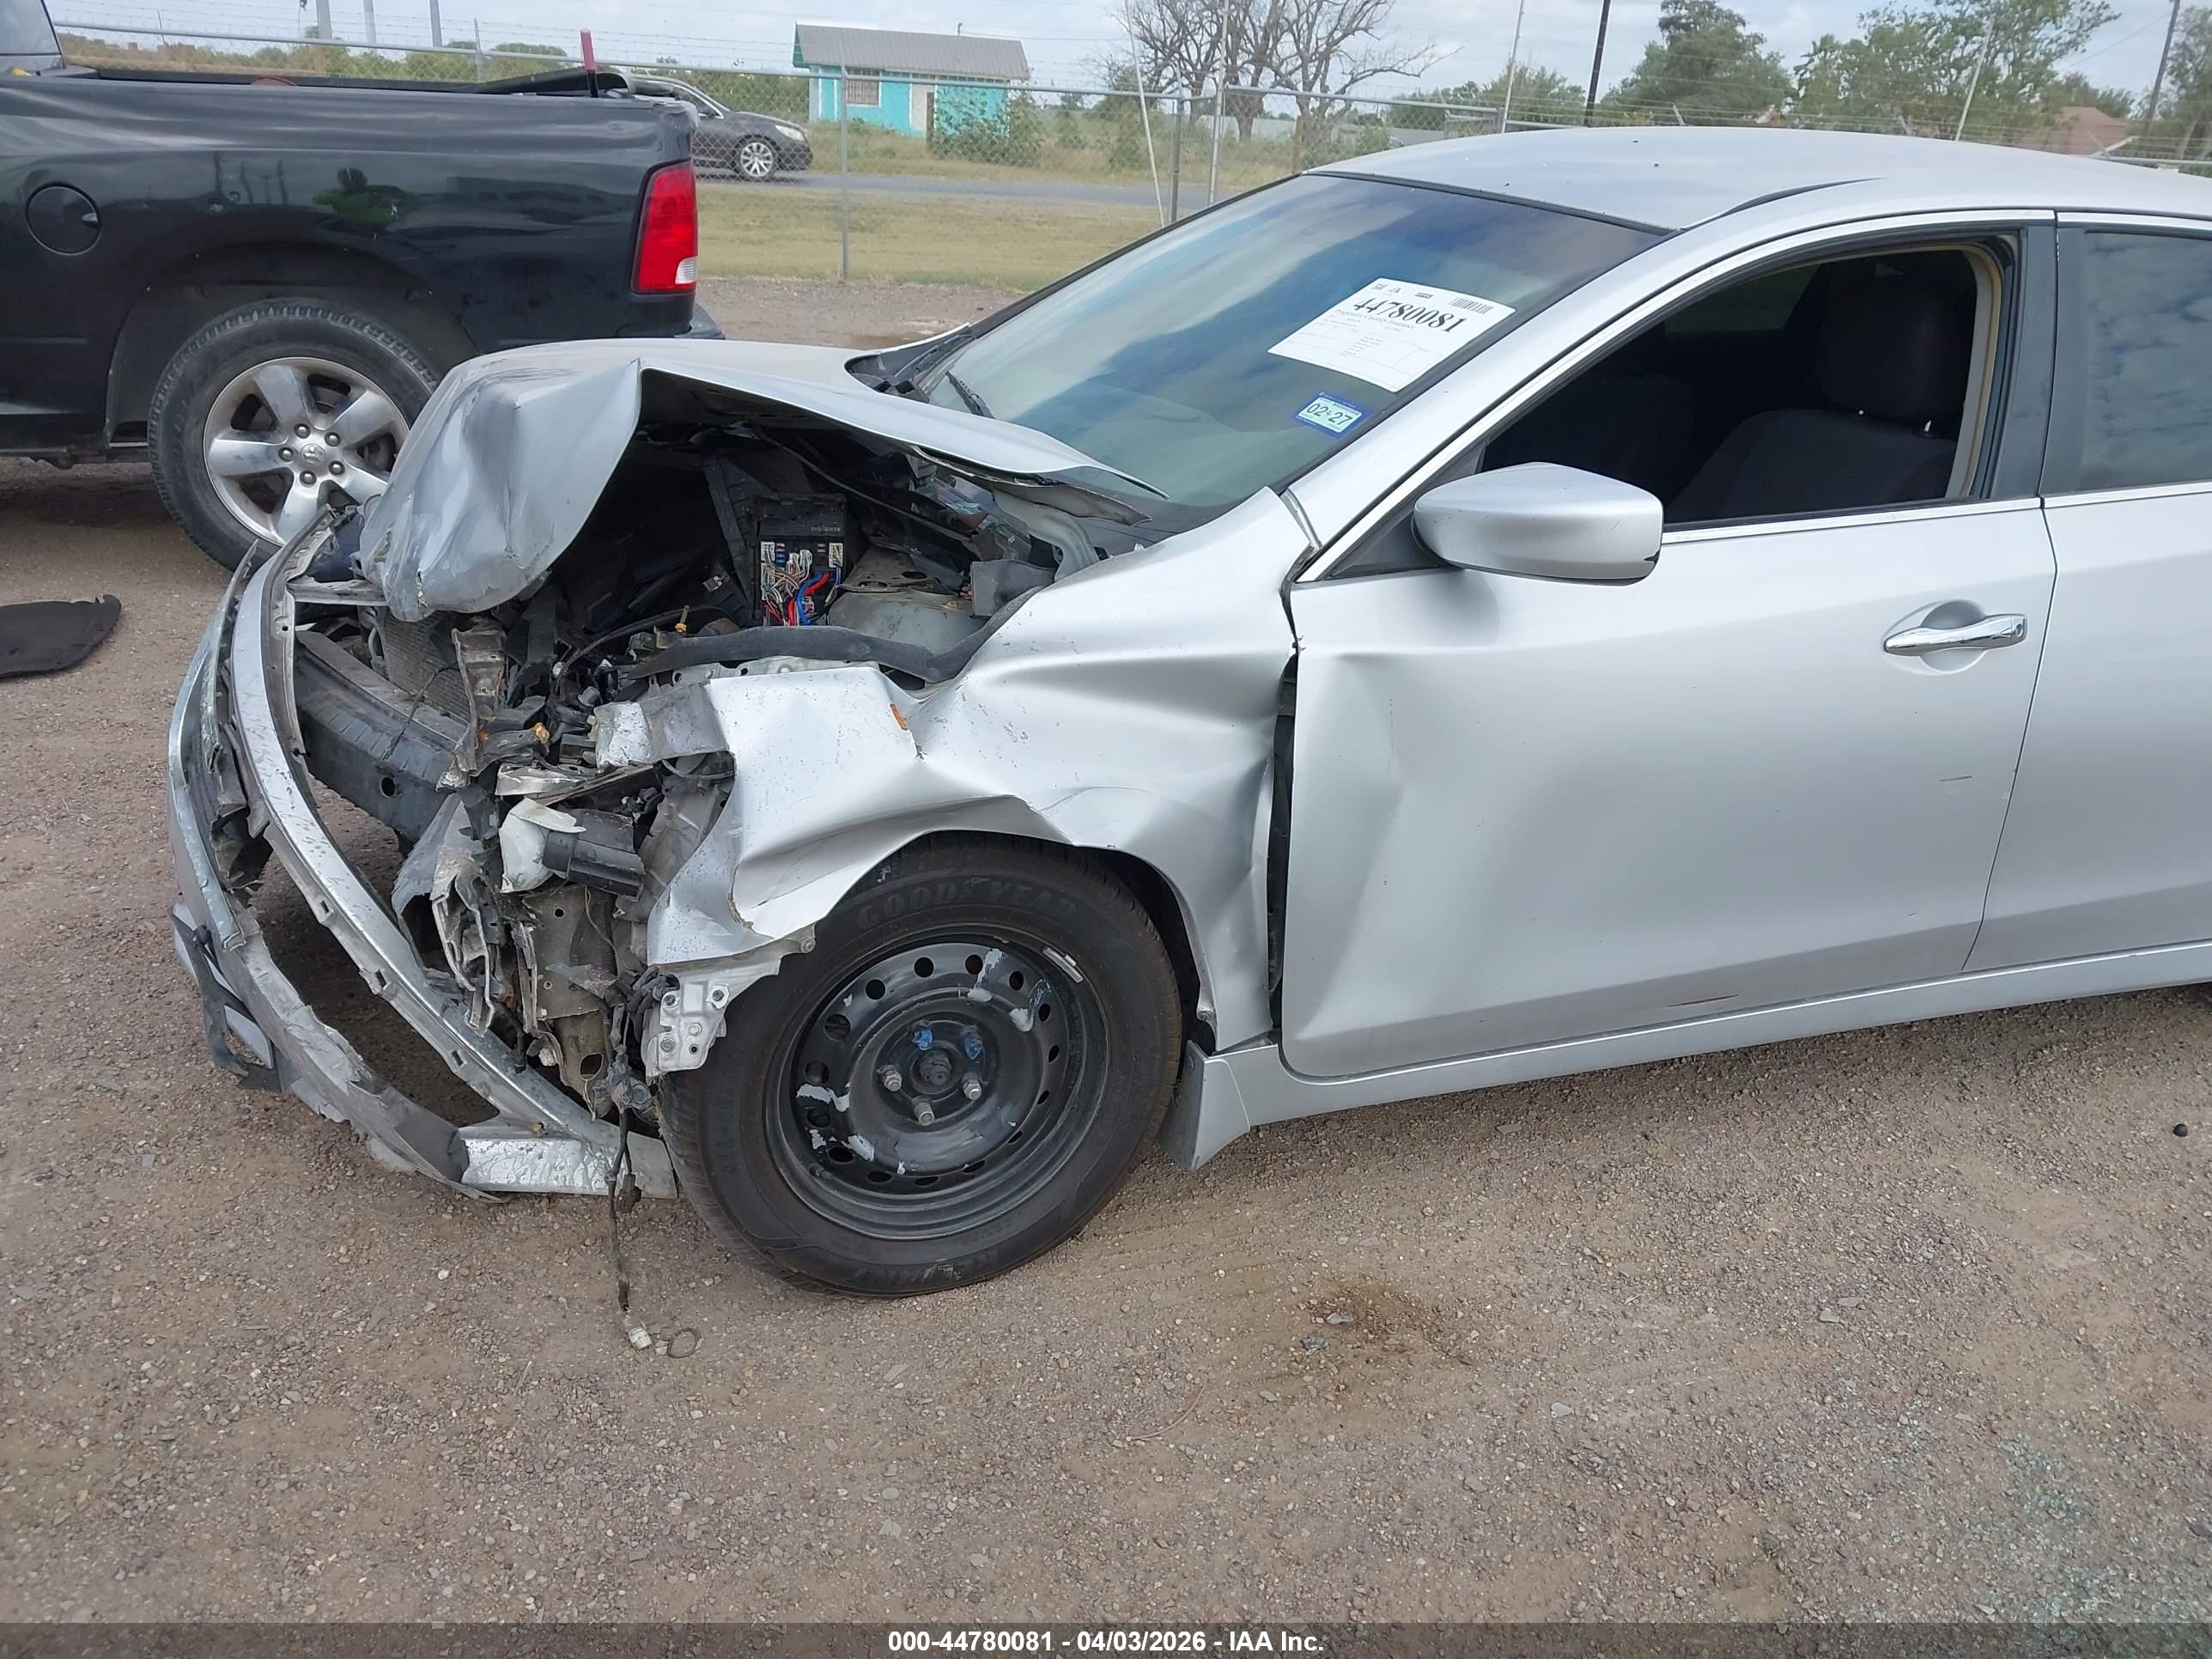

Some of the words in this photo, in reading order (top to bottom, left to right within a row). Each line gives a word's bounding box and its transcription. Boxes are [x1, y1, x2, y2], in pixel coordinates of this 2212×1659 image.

[1353, 297, 1467, 332] 44780081
[1307, 404, 1329, 417] 02
[1328, 411, 1353, 426] 27
[856, 878, 1077, 930] GOODYEAR
